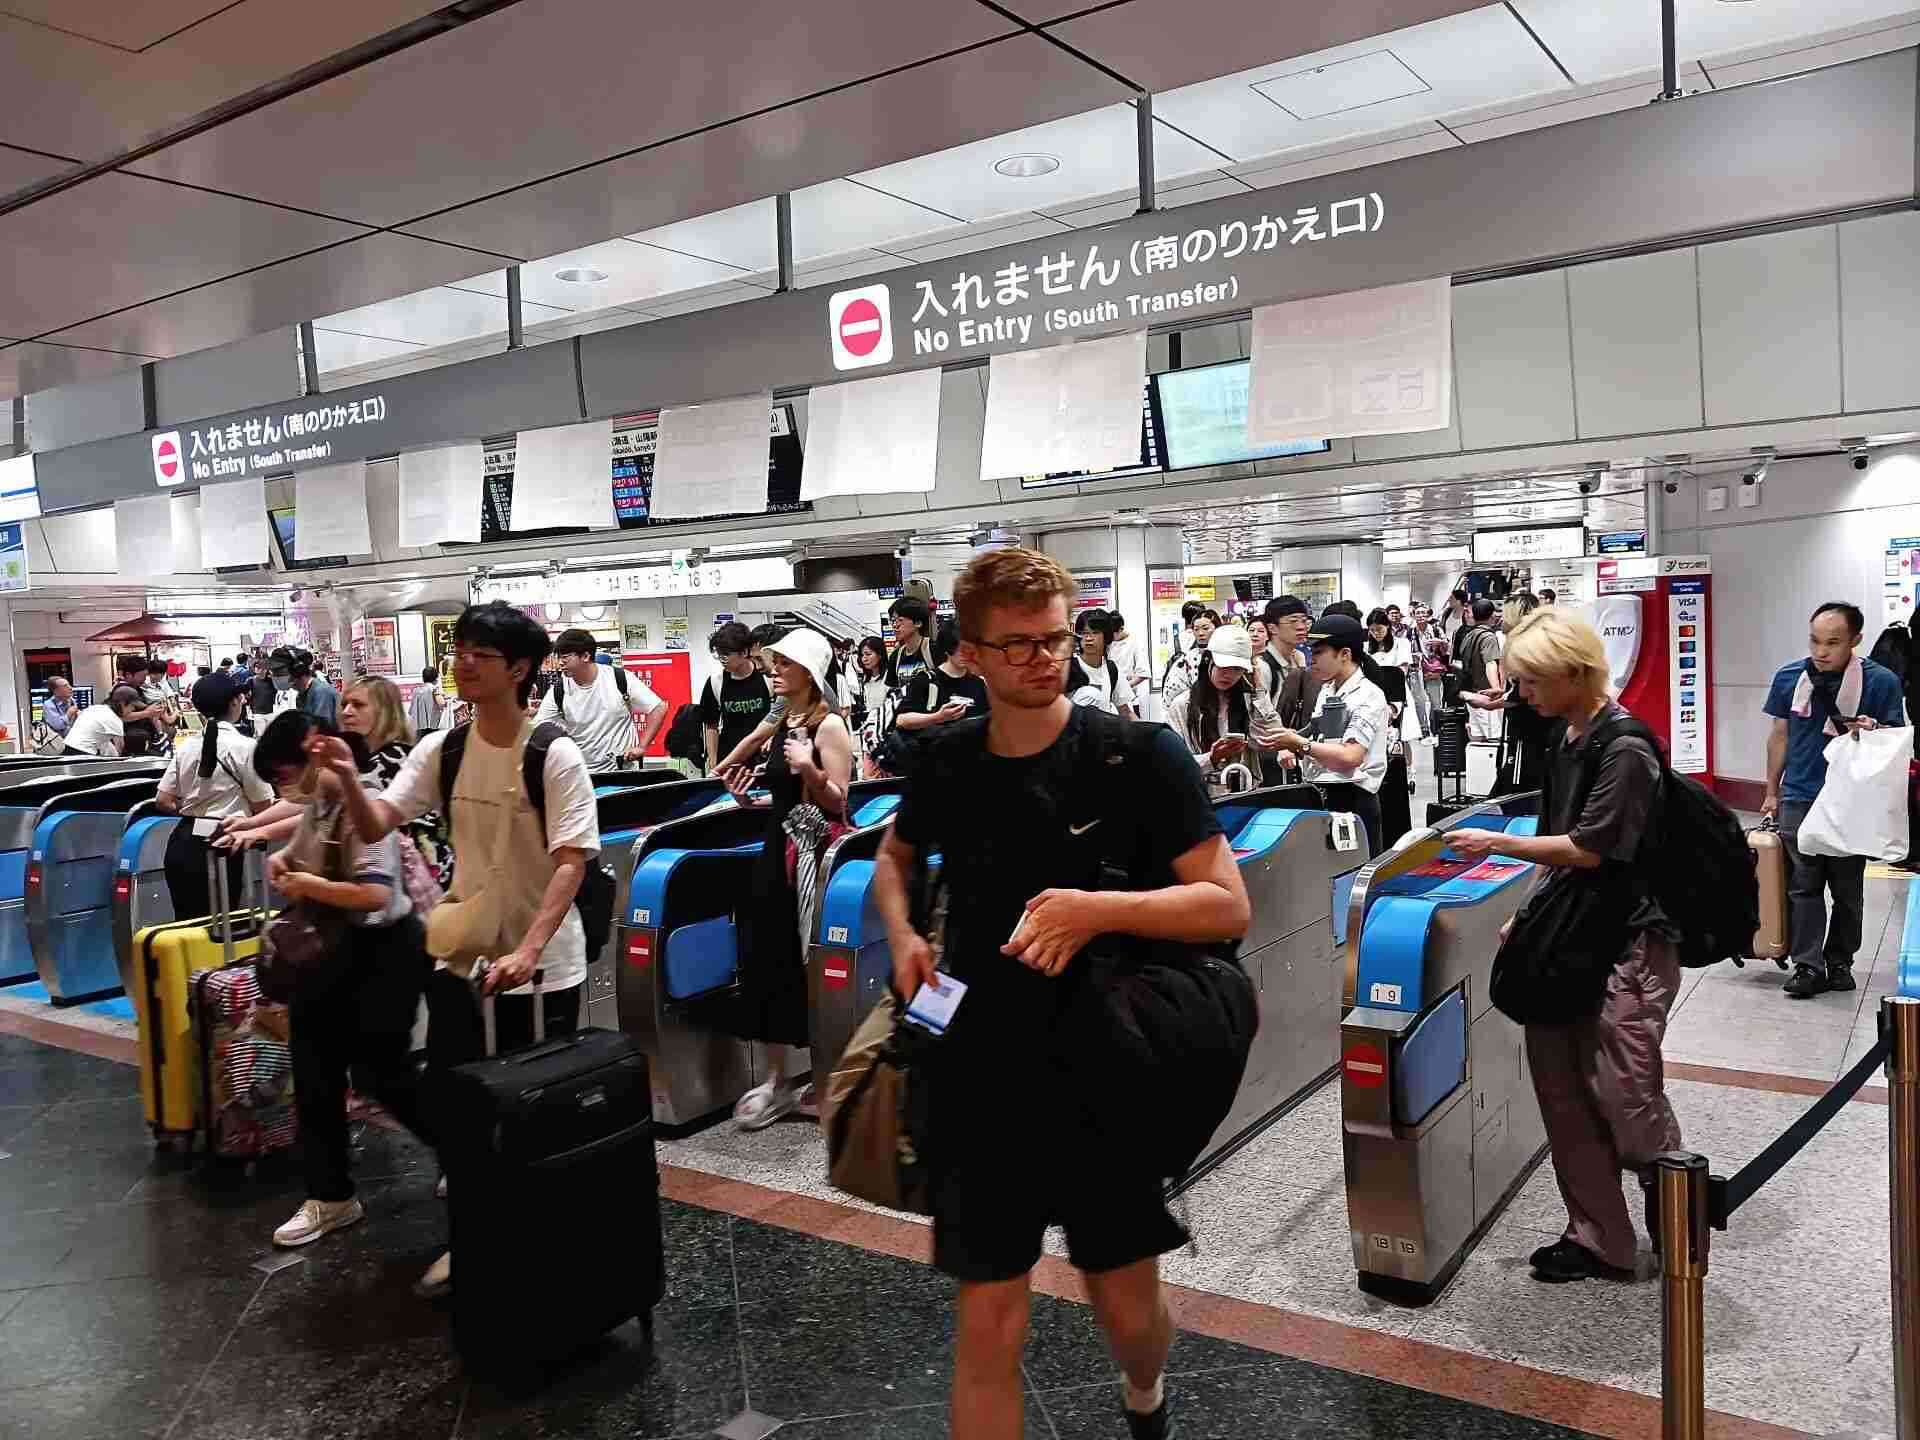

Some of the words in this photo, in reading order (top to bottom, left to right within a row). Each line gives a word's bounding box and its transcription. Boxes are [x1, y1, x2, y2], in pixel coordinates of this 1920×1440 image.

[913, 328, 949, 354] No
[958, 313, 1033, 347] Entry
[1044, 300, 1119, 331] (South
[1126, 276, 1239, 316] Transfer)
[193, 461, 210, 479] No
[212, 454, 246, 476] Entry
[250, 449, 283, 469] (South
[285, 440, 331, 462] Transfer)
[1678, 598, 1697, 607] VISA
[1603, 626, 1626, 637] ATM
[724, 697, 763, 713] Kappa
[1374, 988, 1397, 1003] 19
